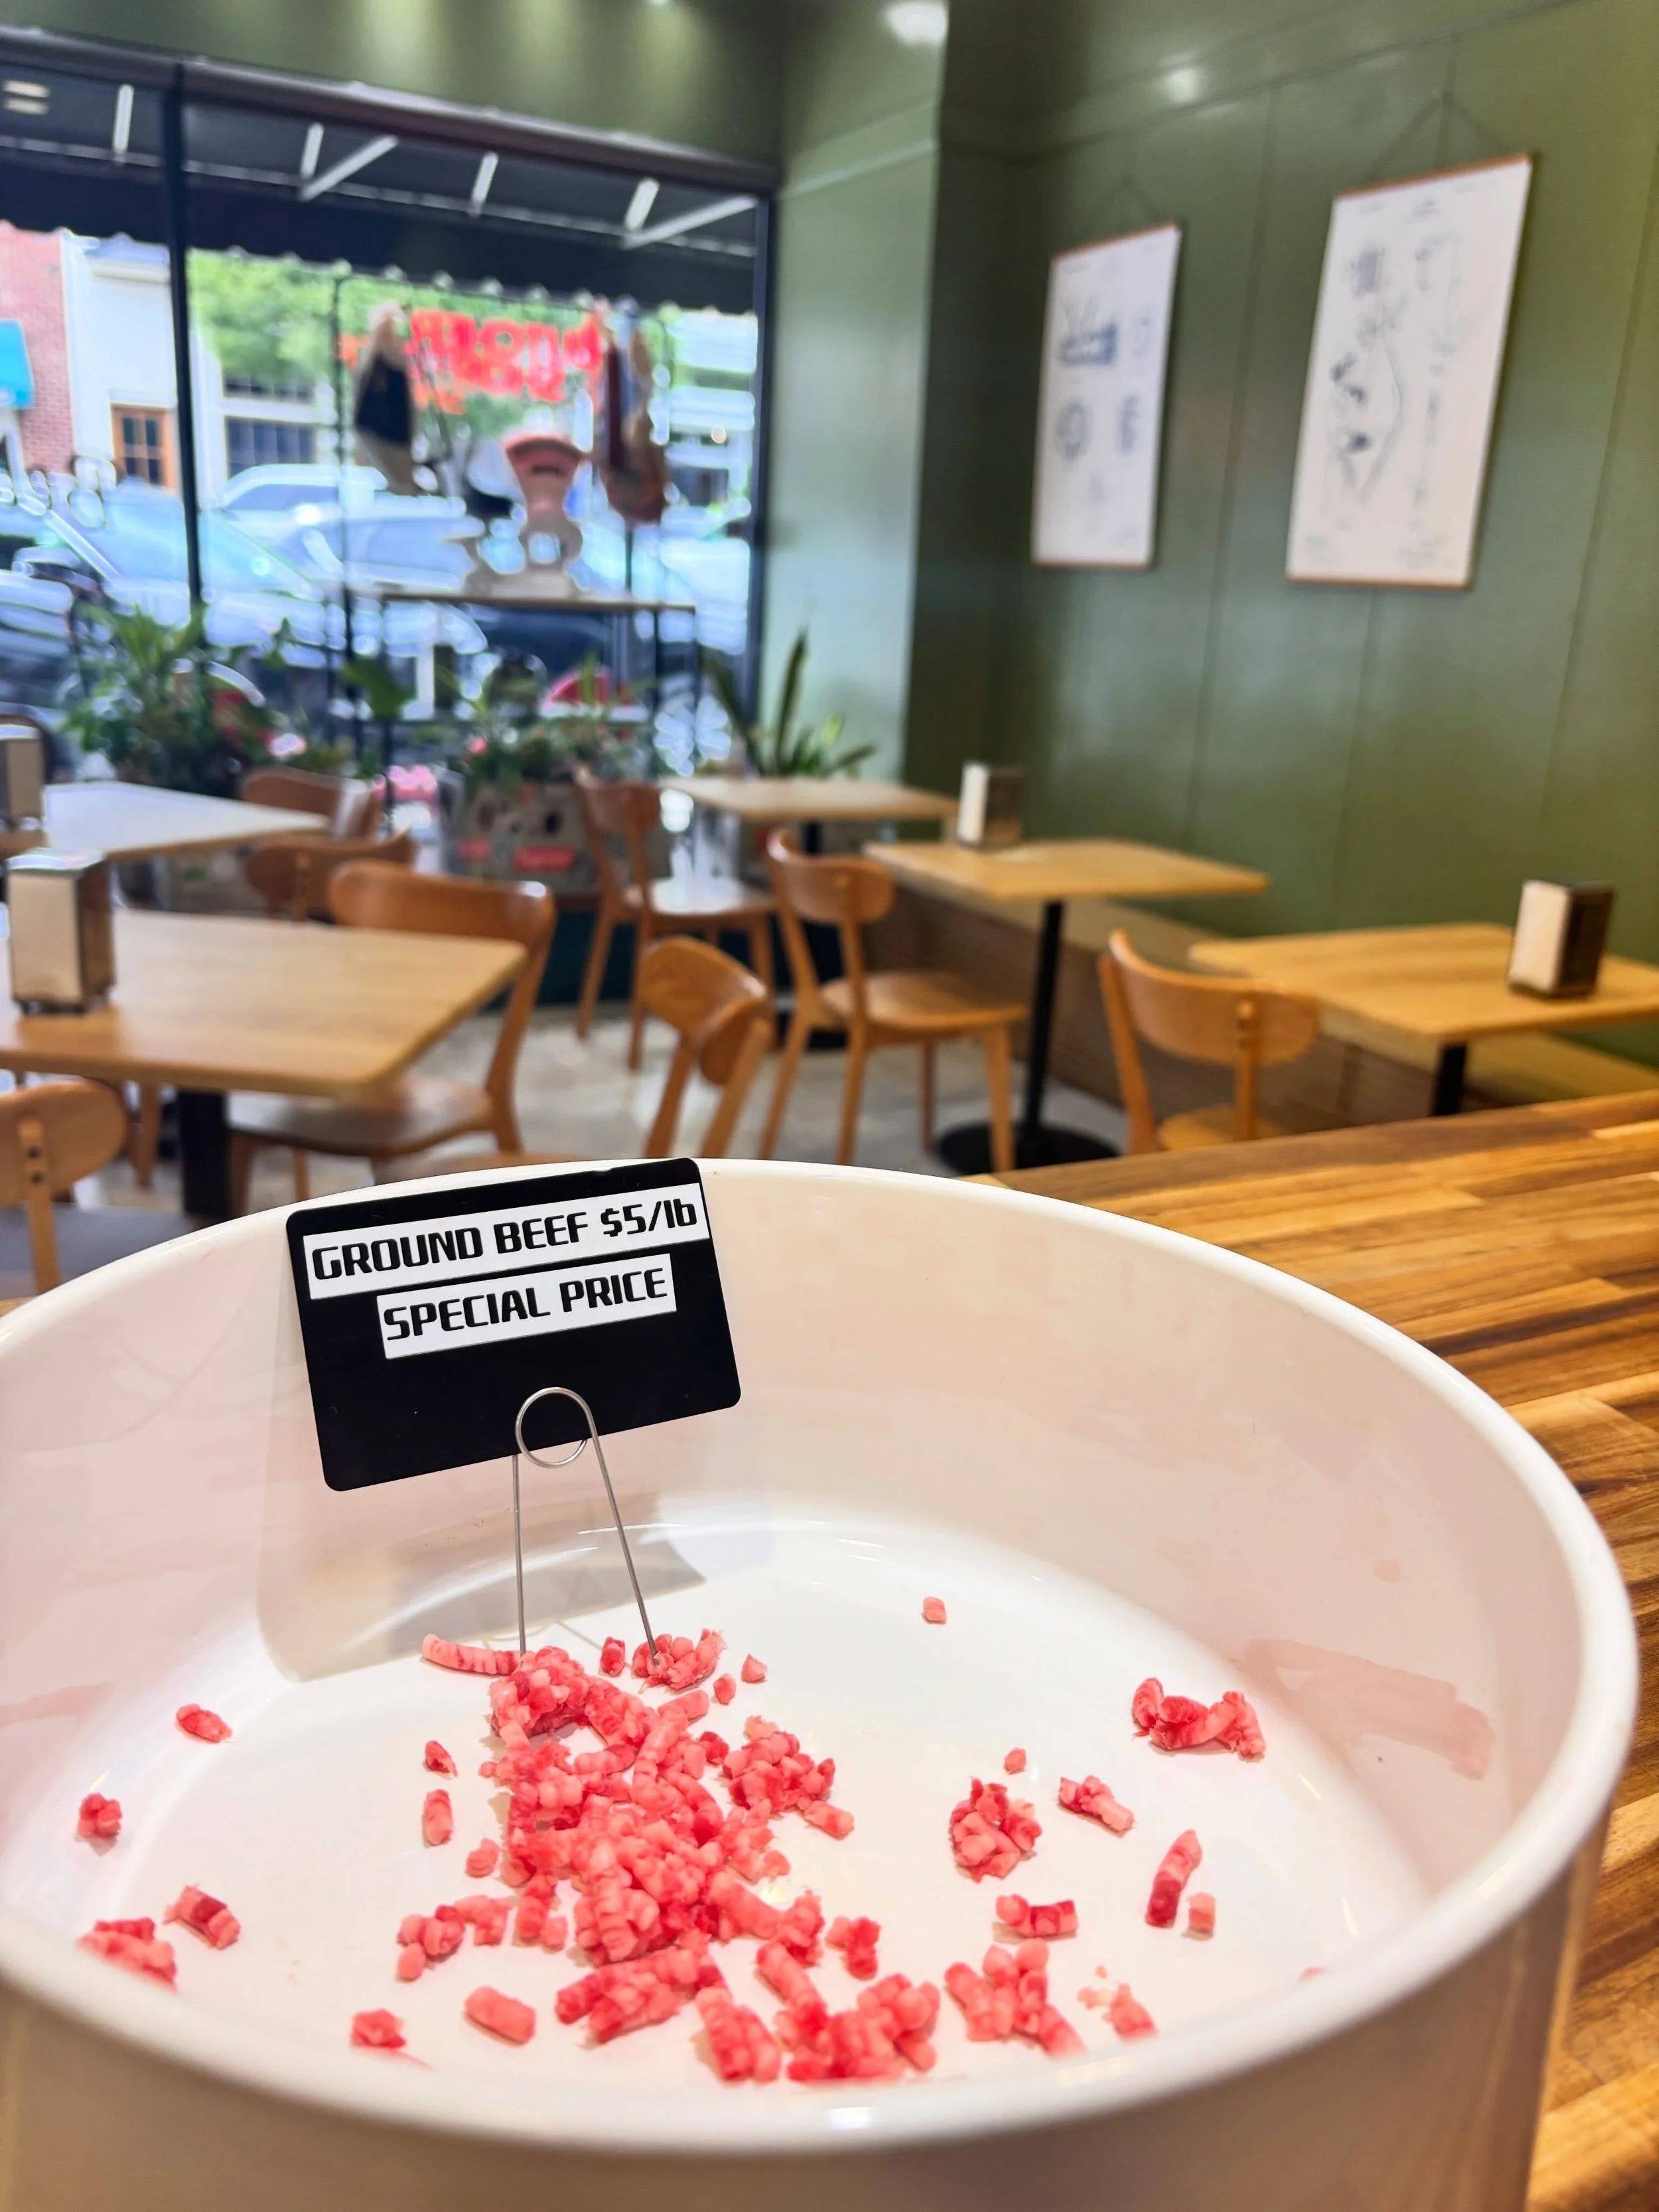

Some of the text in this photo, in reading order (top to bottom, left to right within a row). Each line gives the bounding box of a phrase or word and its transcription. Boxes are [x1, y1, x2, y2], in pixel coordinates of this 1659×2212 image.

[312, 1198, 697, 1280] GROUND BEEF $5/lb
[384, 1268, 668, 1341] SPECIAL PRICE
